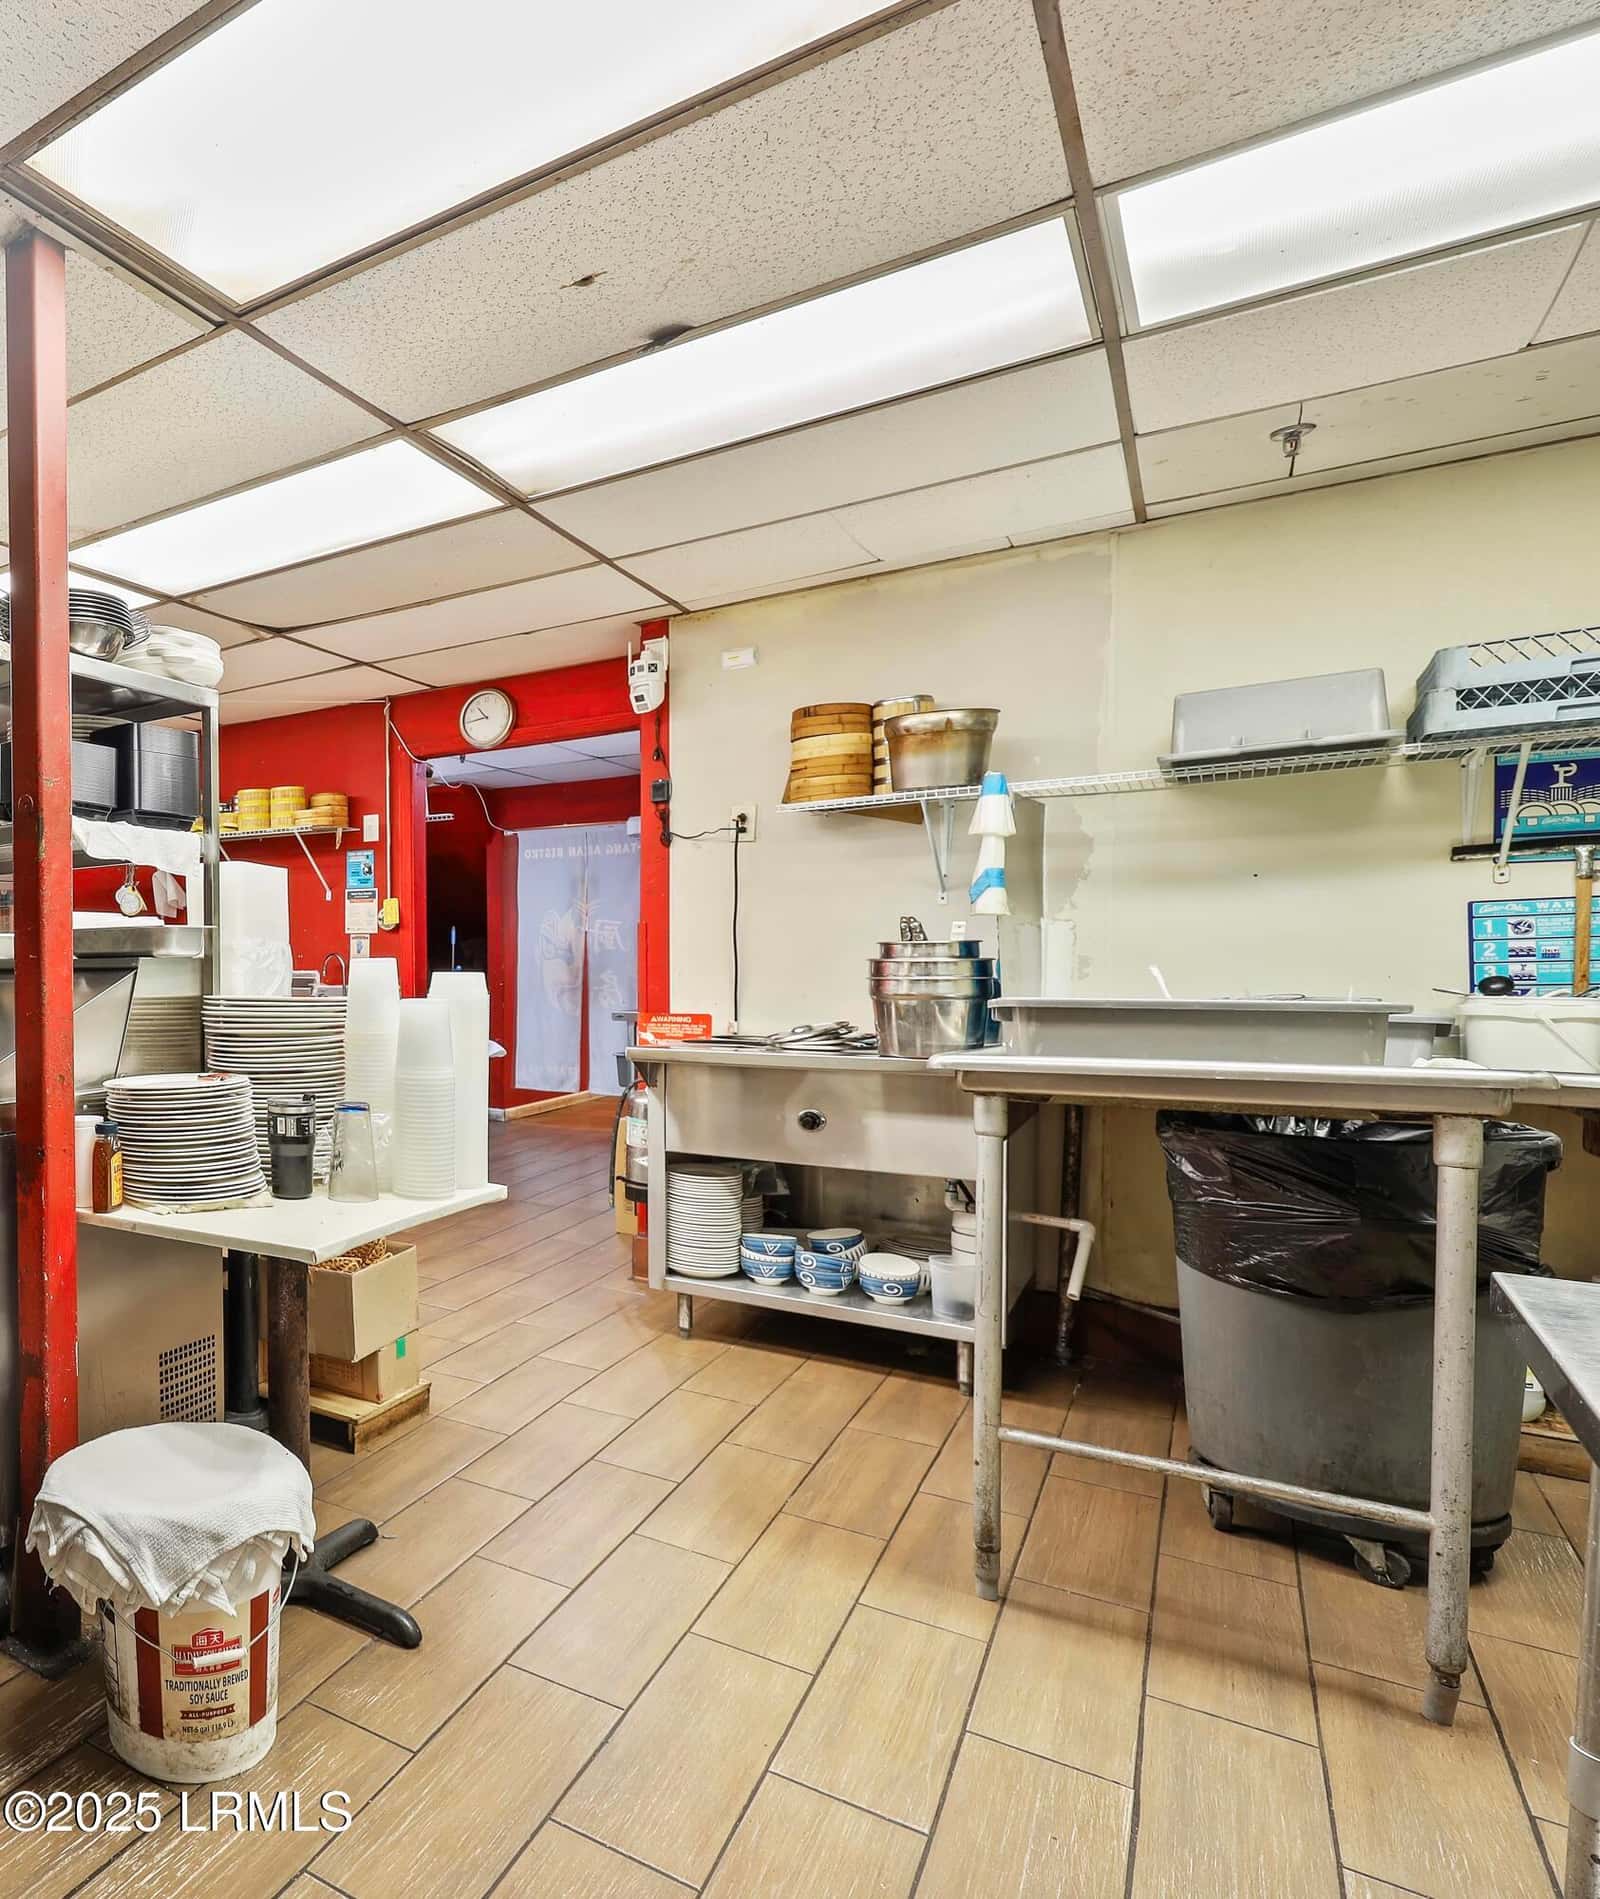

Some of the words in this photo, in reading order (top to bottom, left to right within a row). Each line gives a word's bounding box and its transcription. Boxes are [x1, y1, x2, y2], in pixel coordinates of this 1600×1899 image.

[1483, 919, 1494, 934] 1
[1483, 943, 1497, 957] 2
[165, 1679, 222, 1691] TRADITIONALLY
[222, 1669, 248, 1687] BREWED
[189, 1694, 205, 1705] SOY
[206, 1690, 228, 1703] SAUCE
